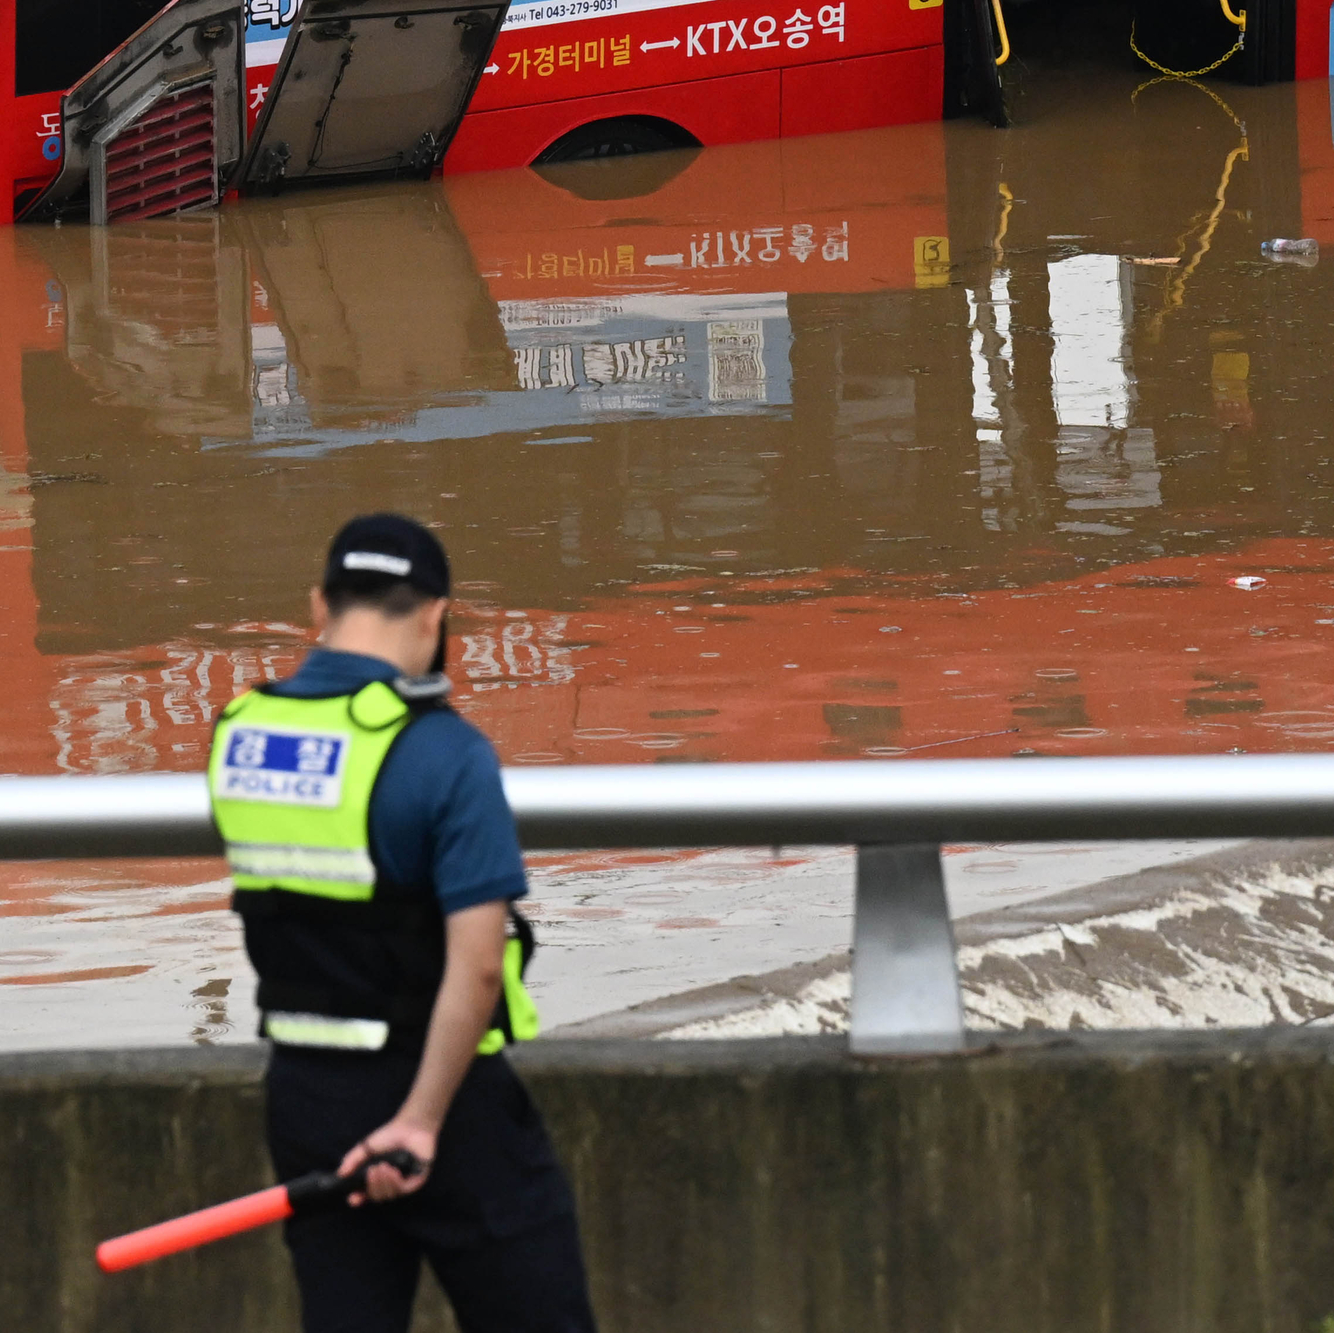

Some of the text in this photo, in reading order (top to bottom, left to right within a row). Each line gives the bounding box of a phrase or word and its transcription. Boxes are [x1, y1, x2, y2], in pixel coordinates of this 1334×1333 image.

[529, 7, 544, 21] Tel
[507, 1, 846, 80] 가경터미널 KTX오송역
[226, 771, 328, 797] POLICE
